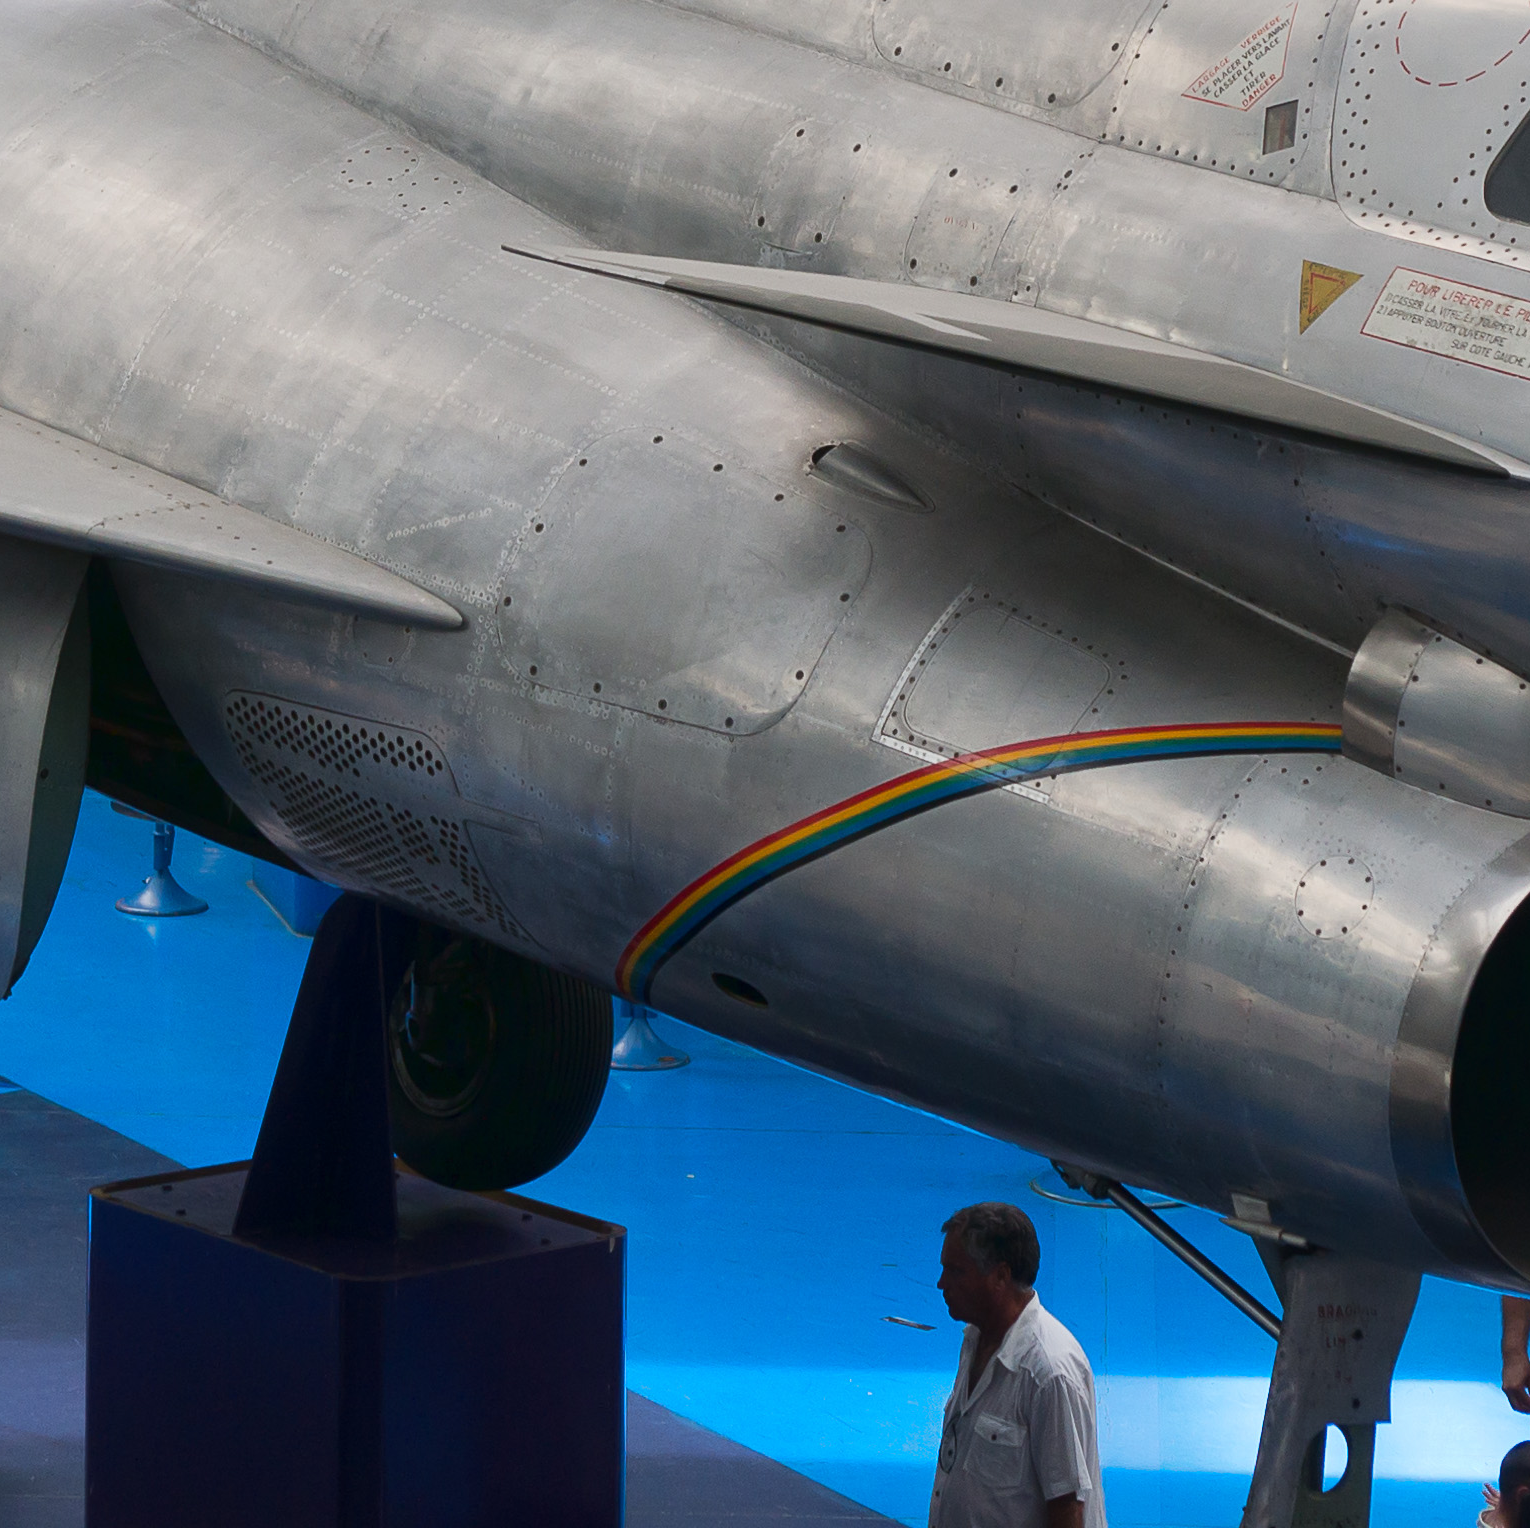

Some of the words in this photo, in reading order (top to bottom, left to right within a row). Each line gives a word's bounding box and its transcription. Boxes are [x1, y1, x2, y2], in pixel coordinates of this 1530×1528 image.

[1192, 56, 1229, 93] LARGAGE
[1212, 58, 1242, 87] PLACER
[1241, 42, 1262, 60] VERS
[1213, 69, 1243, 98] CASSER
[1242, 60, 1254, 72] LA
[1255, 37, 1280, 61] GLACE
[1243, 69, 1254, 83] ET
[1240, 71, 1267, 97] TIRER
[1241, 73, 1277, 108] DANGER
[1407, 279, 1441, 298] POUR
[1442, 288, 1493, 311] LIBERER
[1495, 303, 1514, 318] LE
[1424, 305, 1436, 314] LA
[1515, 327, 1528, 338] LA
[1424, 316, 1457, 336] BOUTON
[1457, 325, 1508, 348] OUVERTURE
[1450, 338, 1468, 352] SUR
[1468, 343, 1492, 359] COTE
[1492, 350, 1527, 368] GAUCHE
